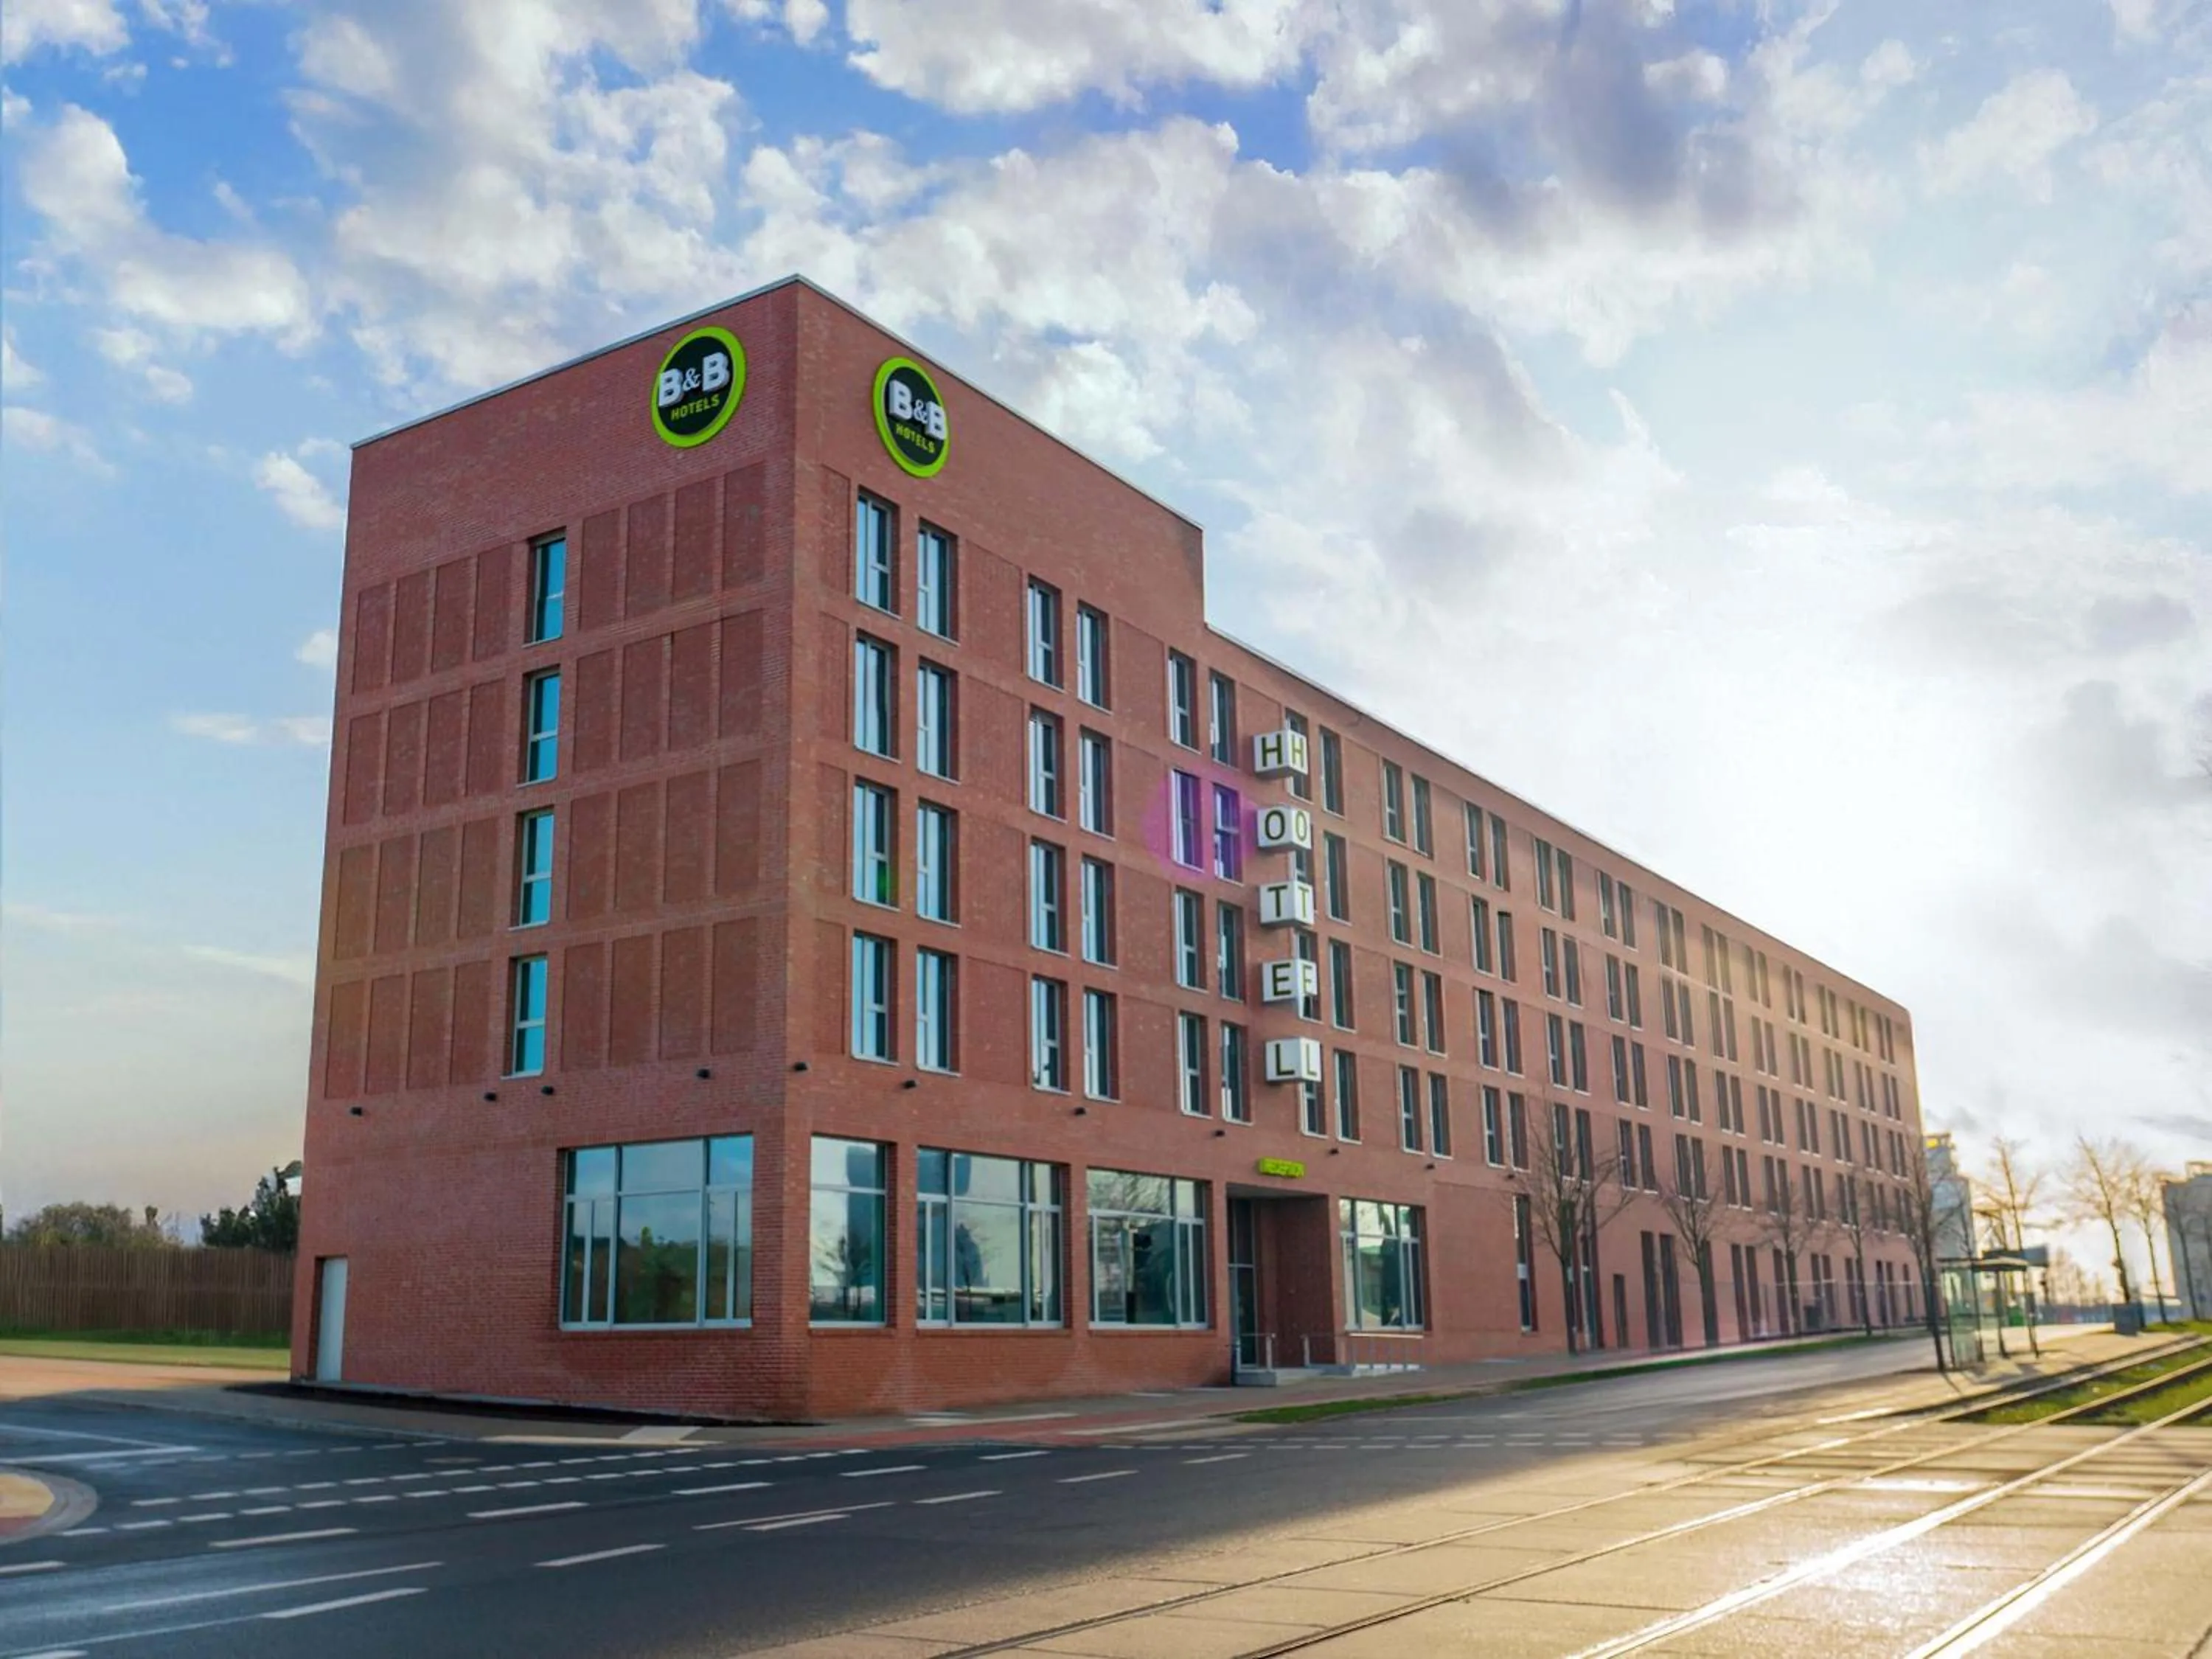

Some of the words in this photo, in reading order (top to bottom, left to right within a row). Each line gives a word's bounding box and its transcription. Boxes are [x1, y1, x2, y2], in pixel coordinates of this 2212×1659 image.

[658, 352, 730, 407] B&B
[670, 394, 720, 421] HOTELS
[889, 380, 947, 440] B&B
[895, 422, 936, 454] HOTELS
[1260, 734, 1295, 1077] HOTEL
